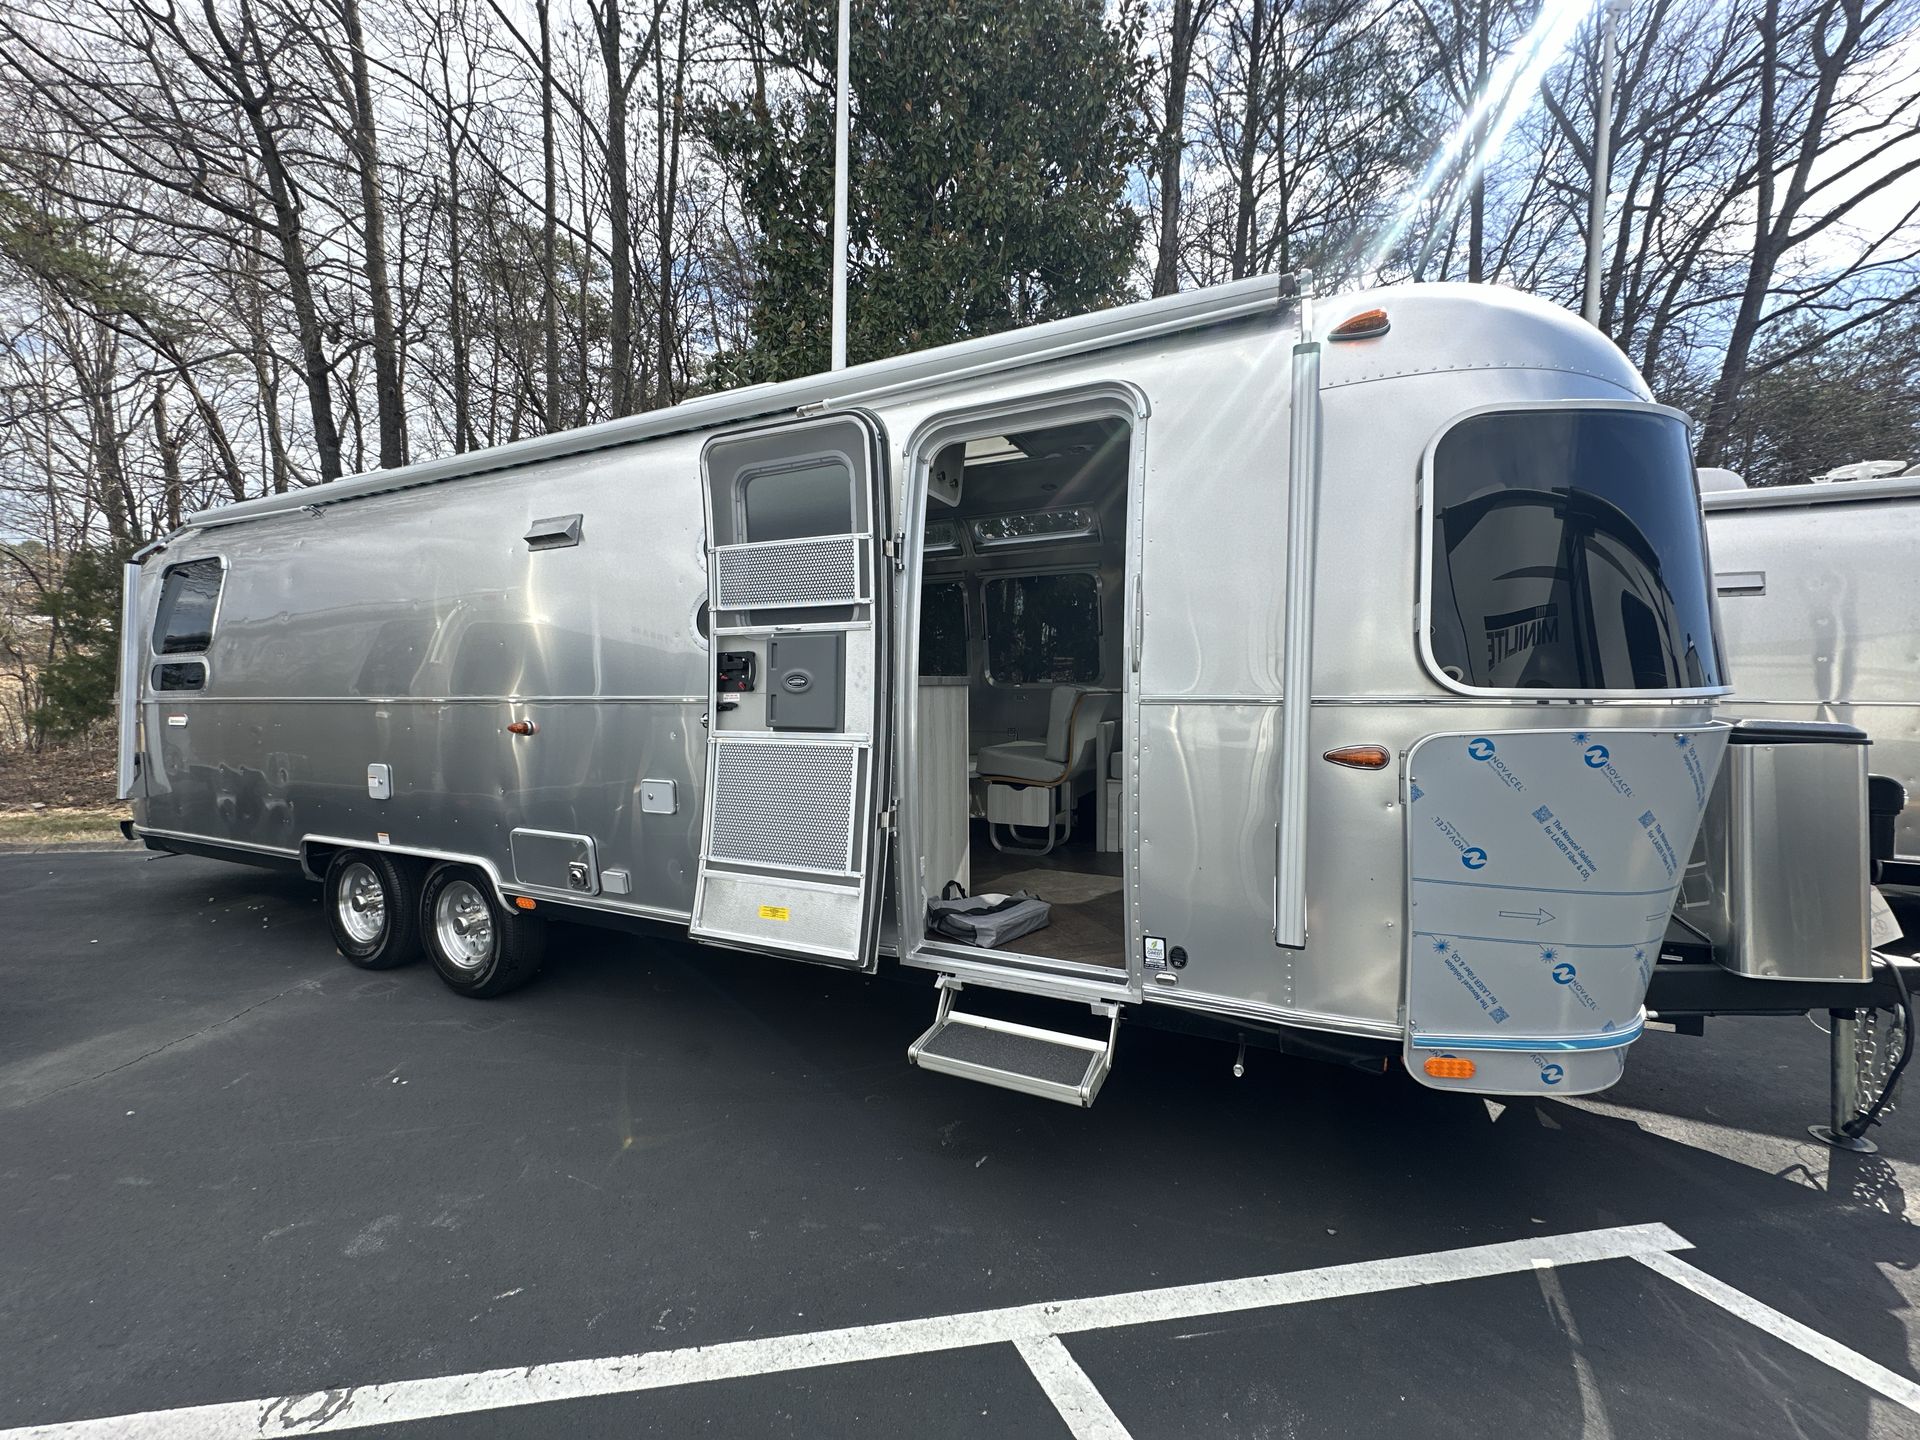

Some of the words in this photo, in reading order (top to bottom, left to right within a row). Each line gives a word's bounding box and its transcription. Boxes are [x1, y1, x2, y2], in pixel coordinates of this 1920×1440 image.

[1492, 756, 1523, 792] NOVACEL
[1605, 763, 1632, 798] NOVACEL
[1434, 816, 1466, 851] NOVACEL
[1544, 825, 1553, 836] for
[1550, 835, 1568, 853] LASER
[1565, 850, 1579, 867] Fiber
[1552, 819, 1563, 832] The
[1561, 830, 1582, 852] Novacel
[1578, 849, 1597, 873] Solution
[1651, 838, 1662, 856] LASER
[1444, 959, 1464, 981] Solution
[1463, 965, 1476, 981] Fiber
[1463, 980, 1482, 1001] Novacel
[1474, 978, 1492, 997] LASER
[1572, 980, 1597, 1011] NOVACEL
[1480, 999, 1489, 1010] The
[1490, 994, 1498, 1005] for
